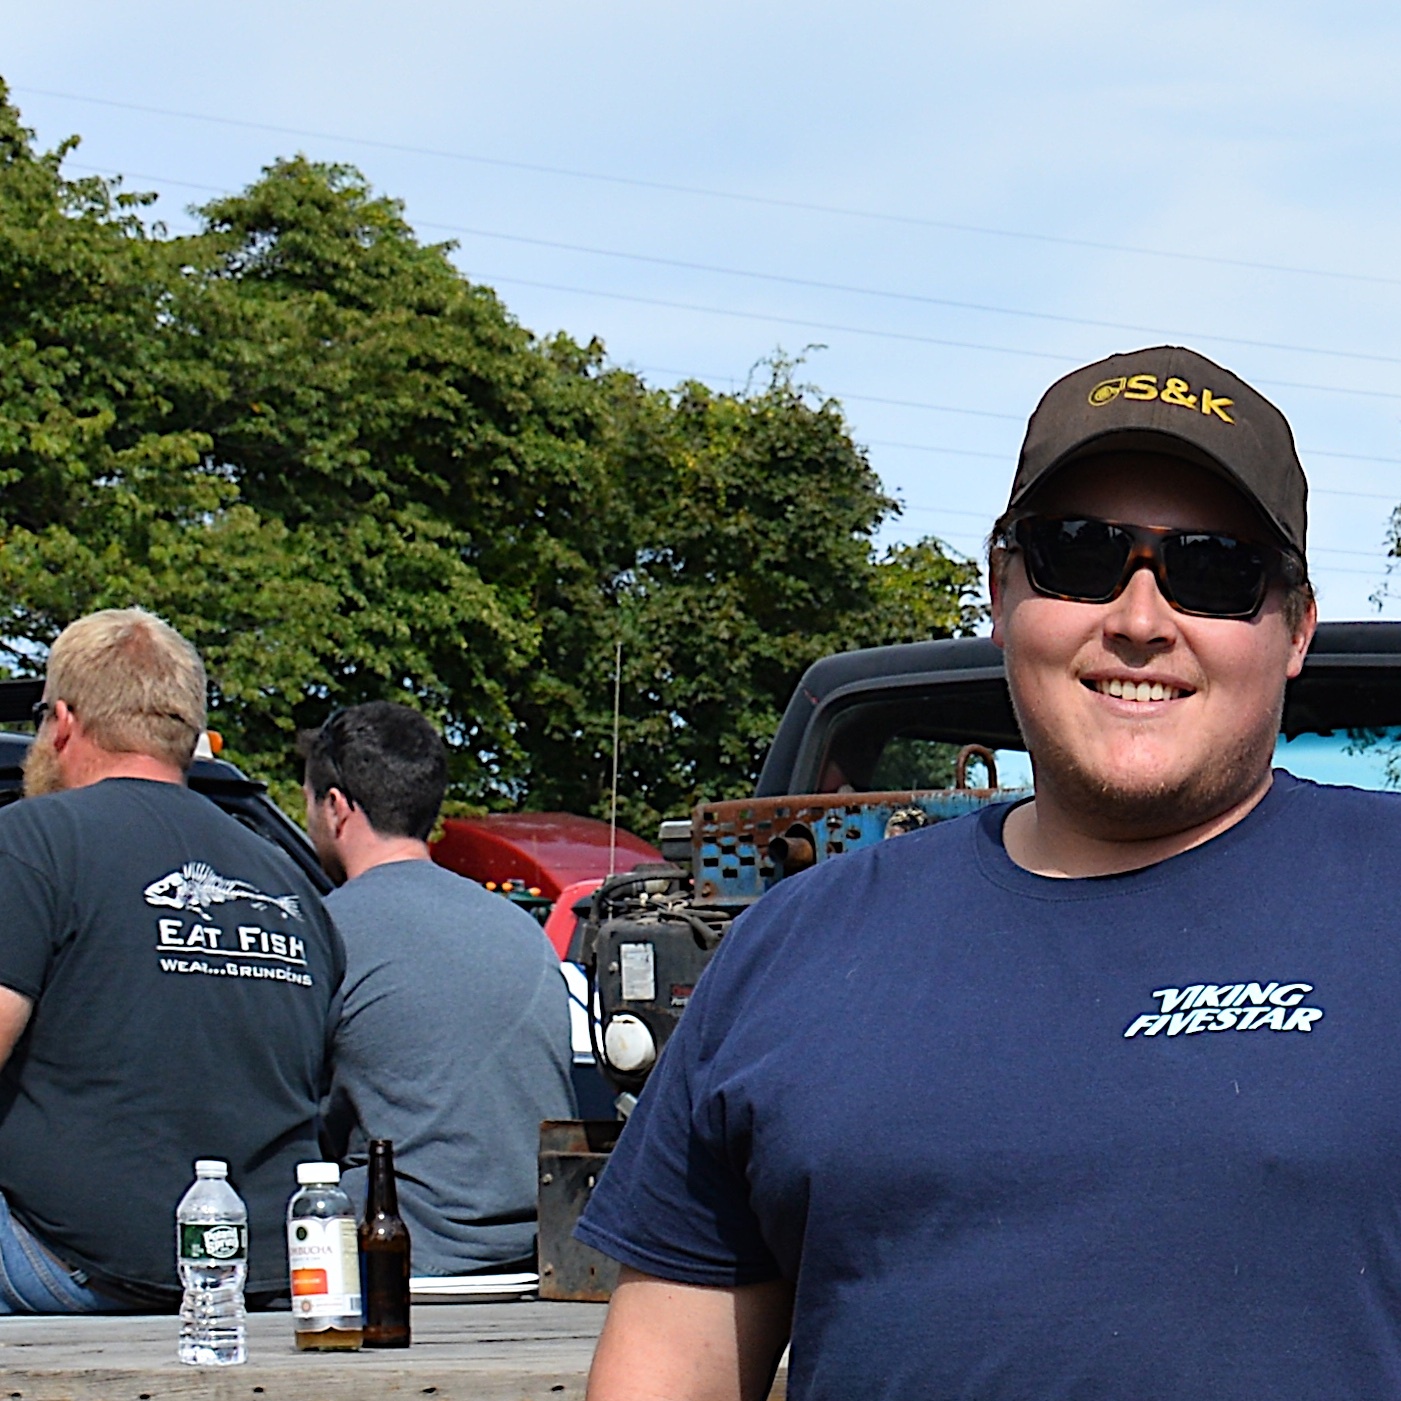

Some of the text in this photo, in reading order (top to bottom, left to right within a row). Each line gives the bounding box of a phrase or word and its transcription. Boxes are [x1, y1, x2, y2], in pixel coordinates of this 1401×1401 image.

[1124, 375, 1236, 425] S&K
[159, 919, 306, 959] EAT FISH
[1152, 982, 1313, 1013] VIKING
[1124, 1006, 1323, 1038] FIVESTAR
